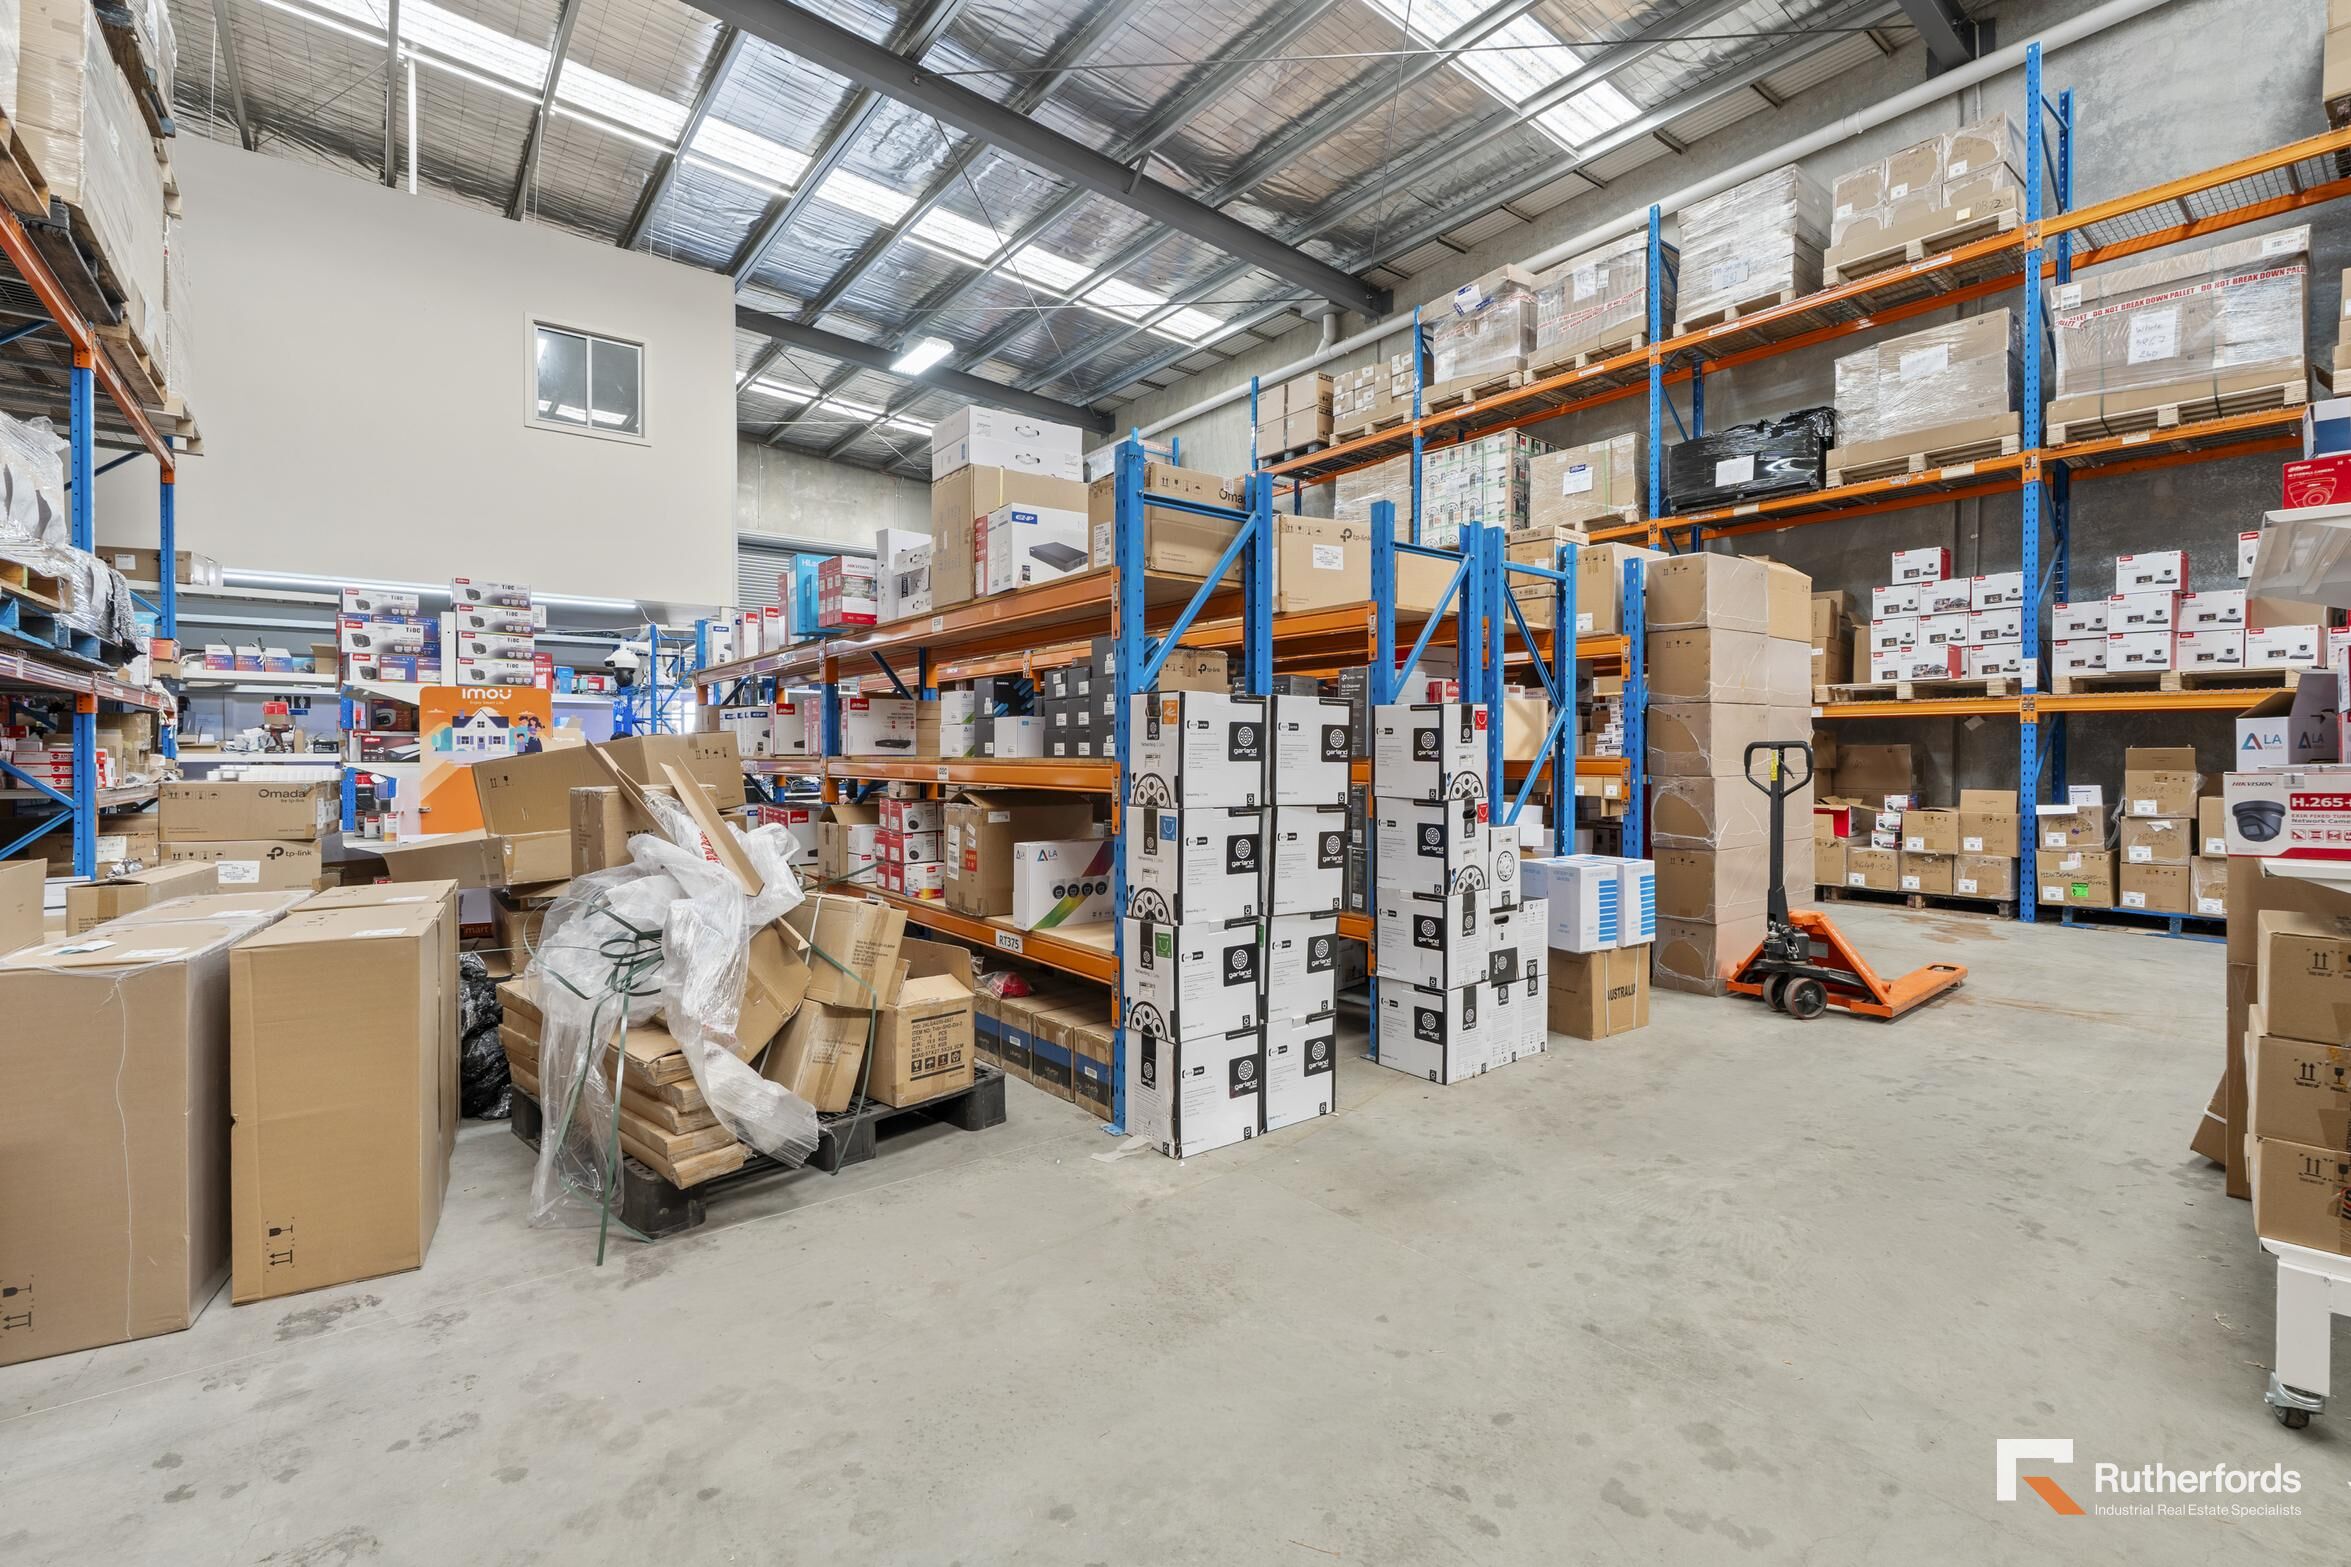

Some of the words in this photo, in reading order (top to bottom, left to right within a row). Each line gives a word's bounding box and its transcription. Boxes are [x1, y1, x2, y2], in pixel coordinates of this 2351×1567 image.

[2201, 284, 2212, 292] DO
[2214, 278, 2230, 289] NOT
[2233, 274, 2258, 285] BREAK
[2260, 268, 2285, 280] DOWN
[2092, 310, 2102, 318] DO
[2105, 306, 2118, 315] NOT
[2121, 301, 2144, 311] BREAK
[2146, 294, 2168, 305] DOWN
[2170, 288, 2195, 299] PALLET
[1233, 748, 1257, 756] garland
[258, 788, 306, 800] Omada
[285, 849, 312, 858] tp-link
[1232, 860, 1254, 868] garland
[998, 934, 1020, 950] RT375
[1418, 936, 1440, 944] garland
[1312, 957, 1332, 967] garland
[1228, 968, 1252, 980] garland
[1308, 1059, 1328, 1070] garland
[1235, 1079, 1258, 1090] garland
